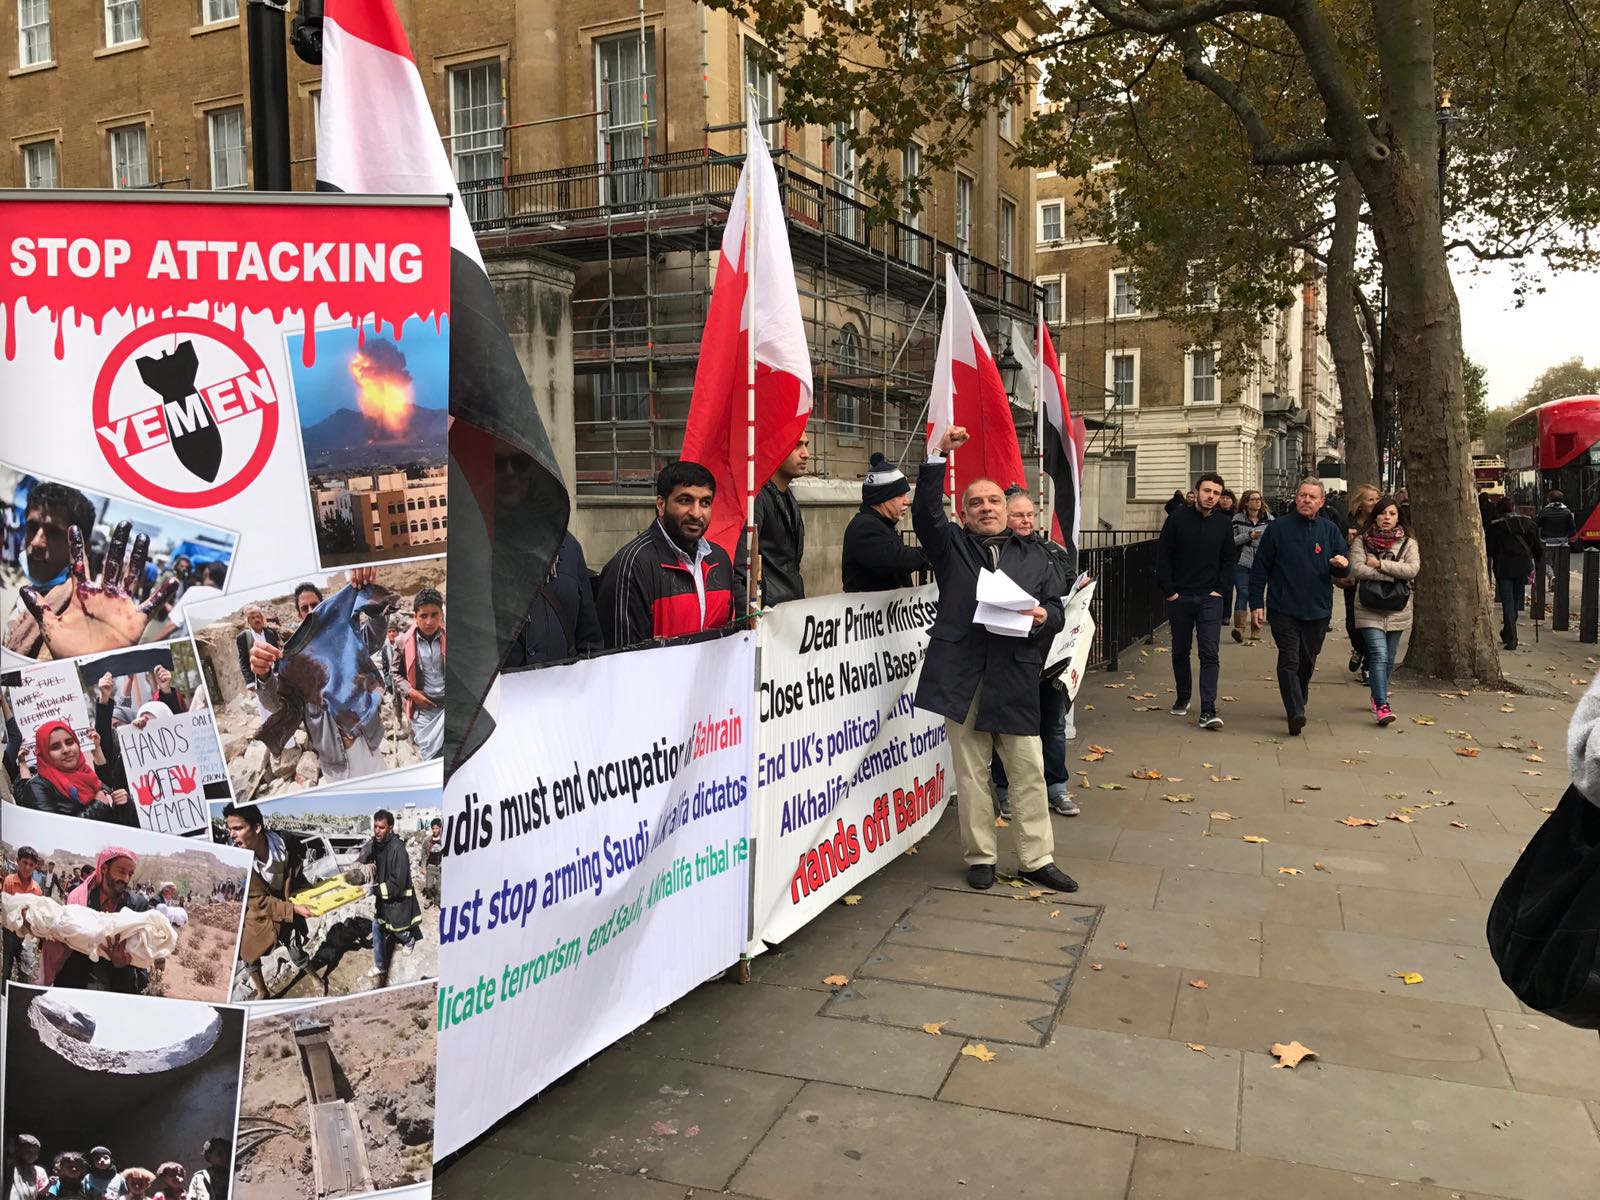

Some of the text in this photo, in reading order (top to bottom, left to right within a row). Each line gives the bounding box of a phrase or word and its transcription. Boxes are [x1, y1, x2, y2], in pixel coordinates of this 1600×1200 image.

[10, 237, 424, 284] STOP ATTACKING
[96, 367, 278, 459] YEMEN
[798, 614, 841, 655] Dear
[844, 603, 884, 645] Prime
[760, 679, 803, 723] Close
[806, 667, 835, 707] the
[839, 652, 883, 696] Naval
[883, 648, 917, 682] Base
[121, 723, 189, 769] HANDS
[147, 765, 181, 802] OFF
[499, 776, 551, 842] must
[553, 760, 586, 820] end
[692, 708, 742, 761] Bahrain
[758, 743, 786, 788] End
[790, 732, 824, 774] UK's
[827, 709, 881, 766] political
[140, 797, 206, 834] YEMEN
[862, 792, 892, 854] off
[892, 762, 946, 835] Bahrain
[439, 889, 484, 945] ust
[487, 879, 538, 928] stop
[542, 847, 603, 897] arming
[499, 937, 582, 1002] terrorism,
[587, 908, 617, 956] end
[695, 839, 729, 882] tribal
